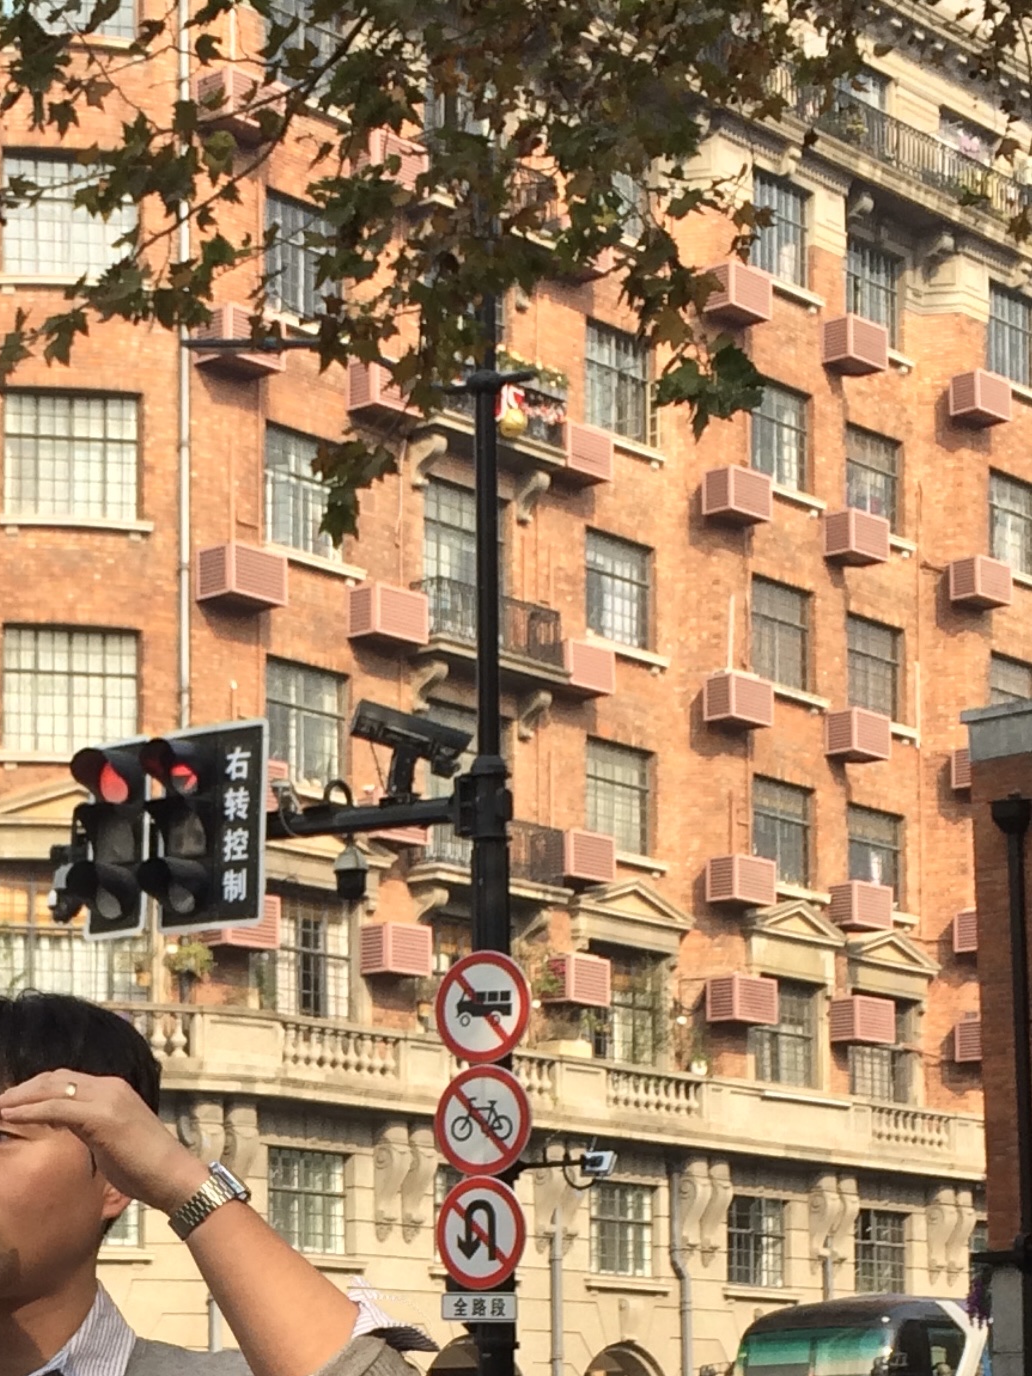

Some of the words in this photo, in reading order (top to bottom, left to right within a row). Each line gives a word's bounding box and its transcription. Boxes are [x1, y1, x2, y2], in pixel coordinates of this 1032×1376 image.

[222, 746, 252, 903] 右转控制
[453, 1297, 506, 1317] 全路段
